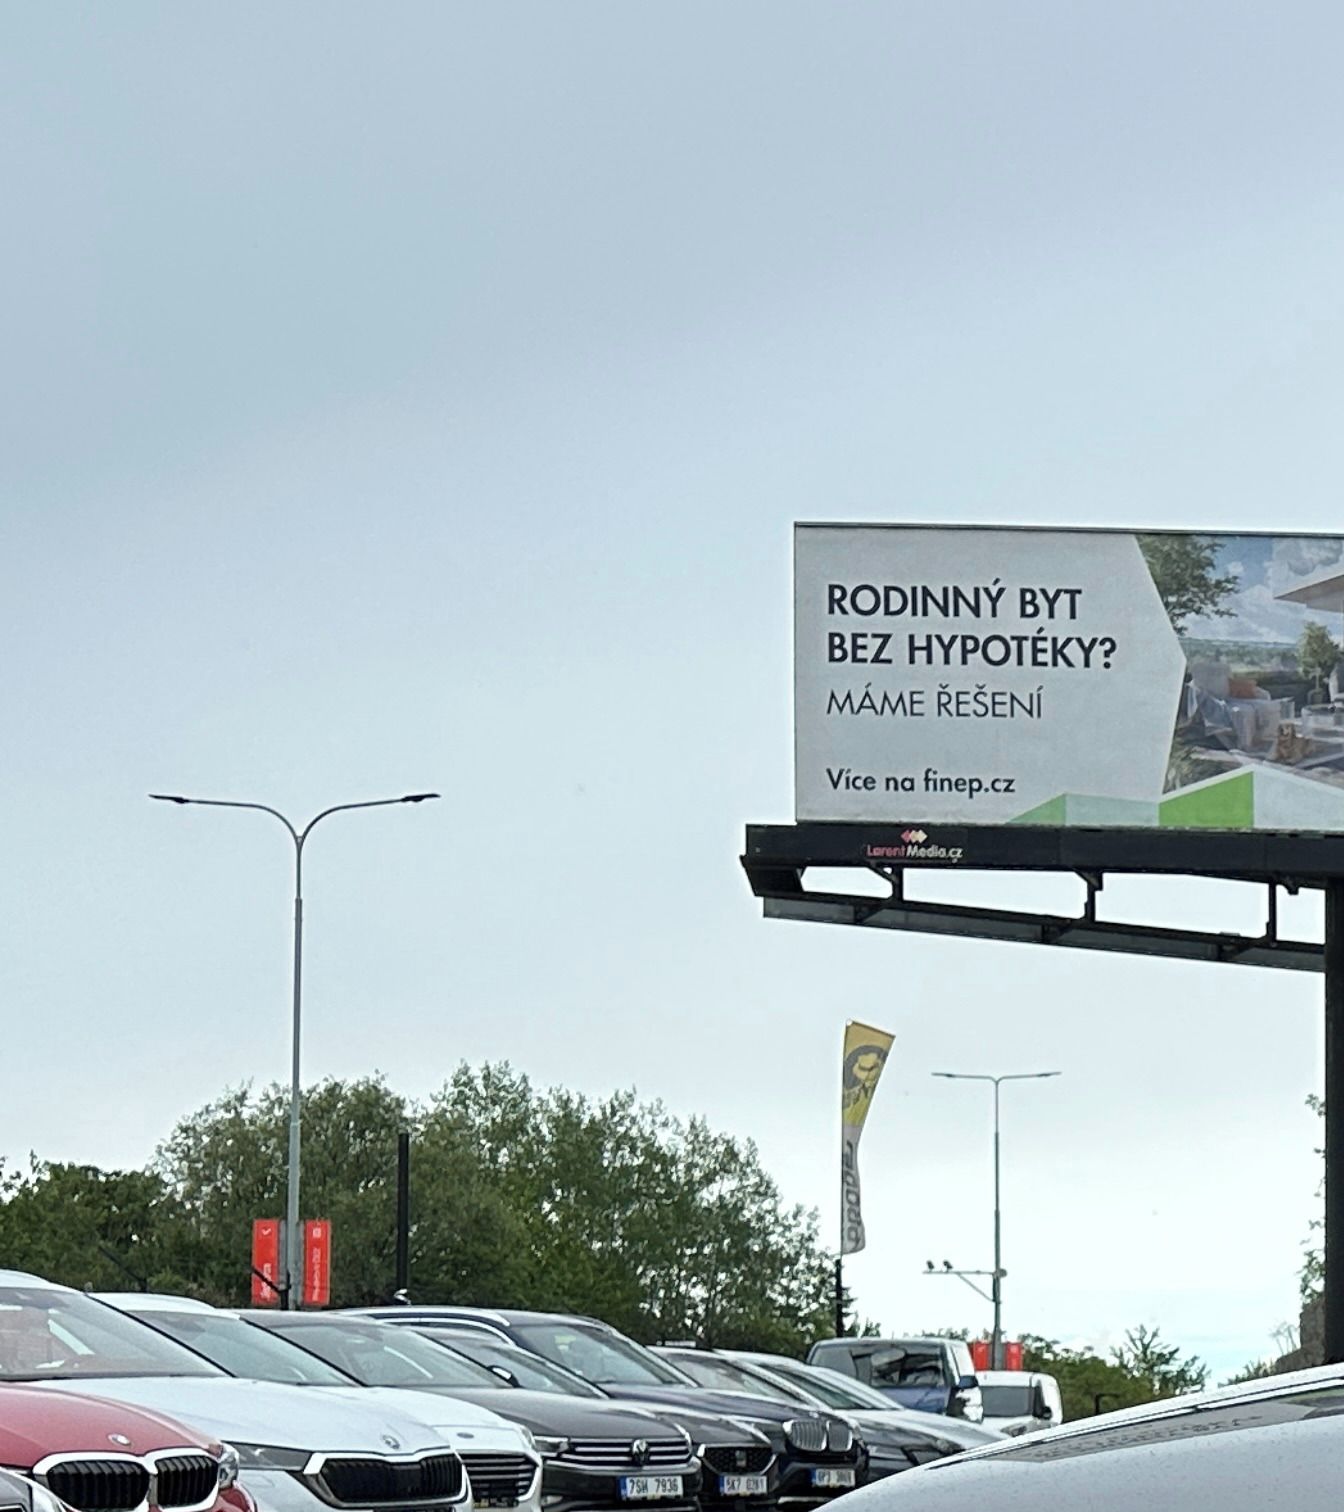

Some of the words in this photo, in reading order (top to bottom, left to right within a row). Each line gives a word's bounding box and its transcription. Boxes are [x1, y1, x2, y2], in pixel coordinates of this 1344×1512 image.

[826, 577, 1007, 619] RODINNÝ
[1019, 587, 1083, 620] BYT
[826, 631, 894, 665] BEZ
[907, 626, 1118, 670] HYPOTÉKY?
[825, 682, 926, 717] MÁME
[936, 683, 1044, 719] ŘEŠENÍ
[825, 767, 877, 791] Více
[885, 776, 915, 792] na
[923, 767, 1016, 799] finep.cz
